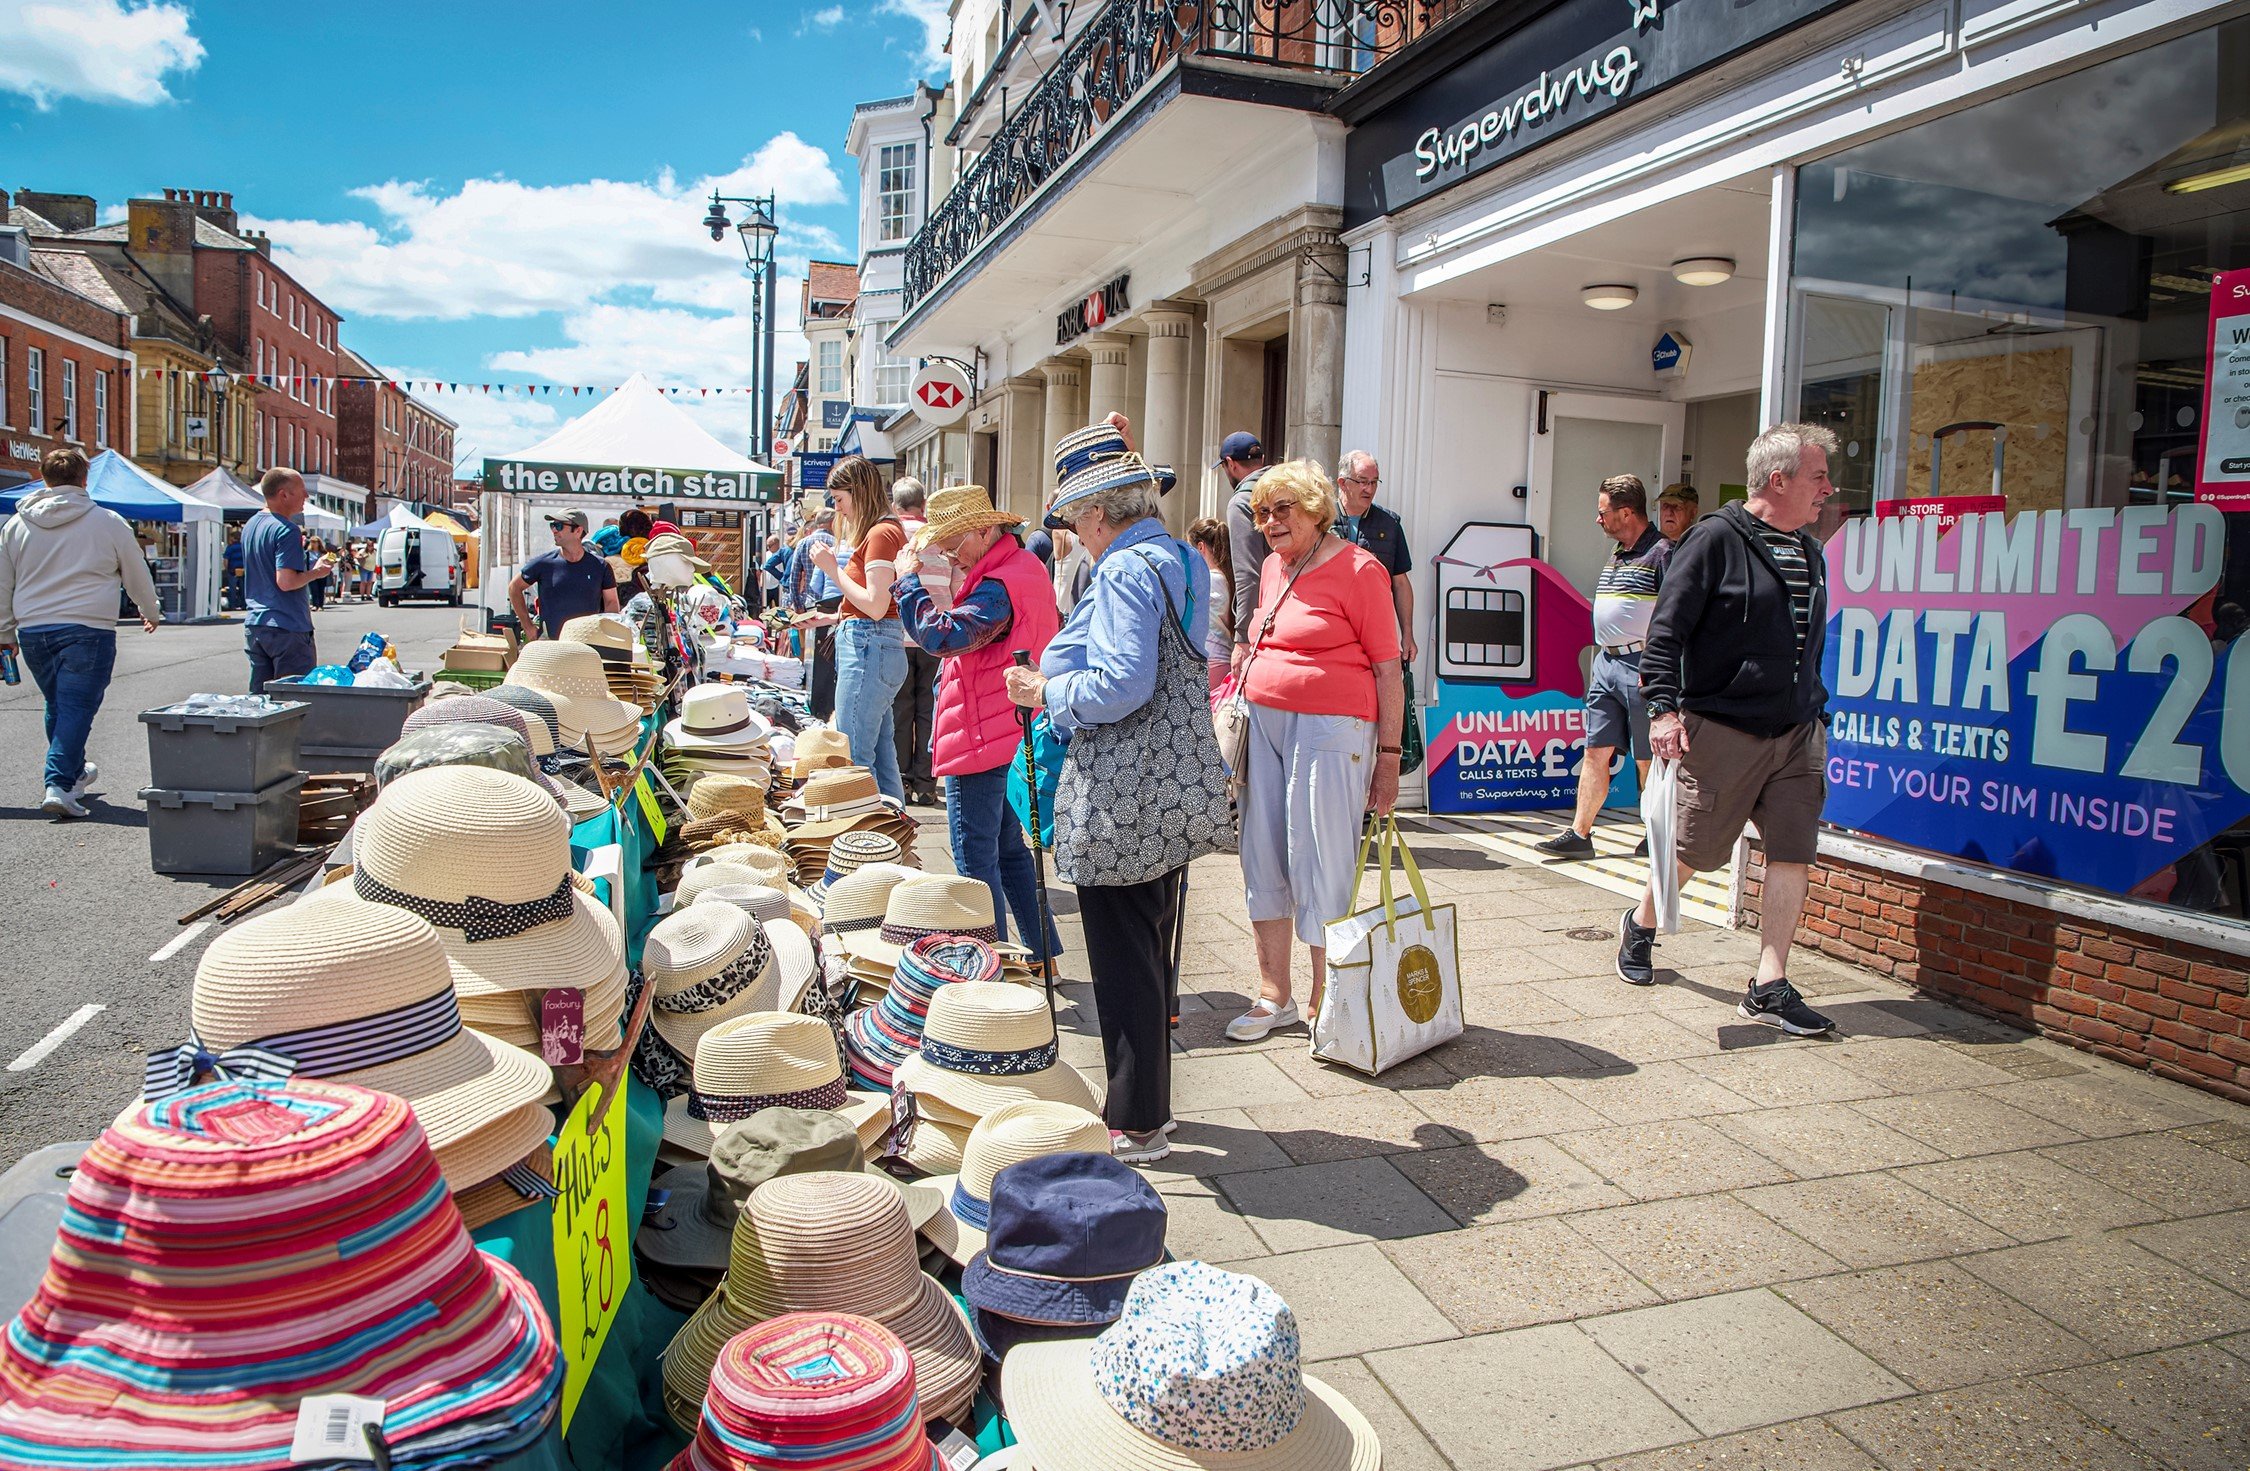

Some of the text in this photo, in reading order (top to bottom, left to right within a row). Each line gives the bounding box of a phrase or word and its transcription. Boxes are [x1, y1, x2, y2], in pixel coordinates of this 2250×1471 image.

[1415, 46, 1638, 178] Superdrug
[1056, 273, 1130, 345] HSBC UK
[10, 440, 41, 462] NatWest
[804, 459, 831, 467] scrivens
[499, 463, 768, 499] the watch stall.
[1899, 503, 1944, 515] IN-STORE
[1843, 503, 2226, 595] UNLIMITED
[1836, 608, 2010, 713] DATA
[1456, 709, 1588, 734] UNLIMITE
[1832, 711, 2010, 762] CALLS & TEXTS
[1458, 739, 1536, 766] DATA
[1459, 768, 1537, 781] CALLS & TEXTS
[1460, 790, 1473, 799] the
[1476, 788, 1548, 800] Superdrug
[1827, 756, 2177, 843] GET YOUR SIM INSIDE
[580, 1198, 613, 1362] £8
